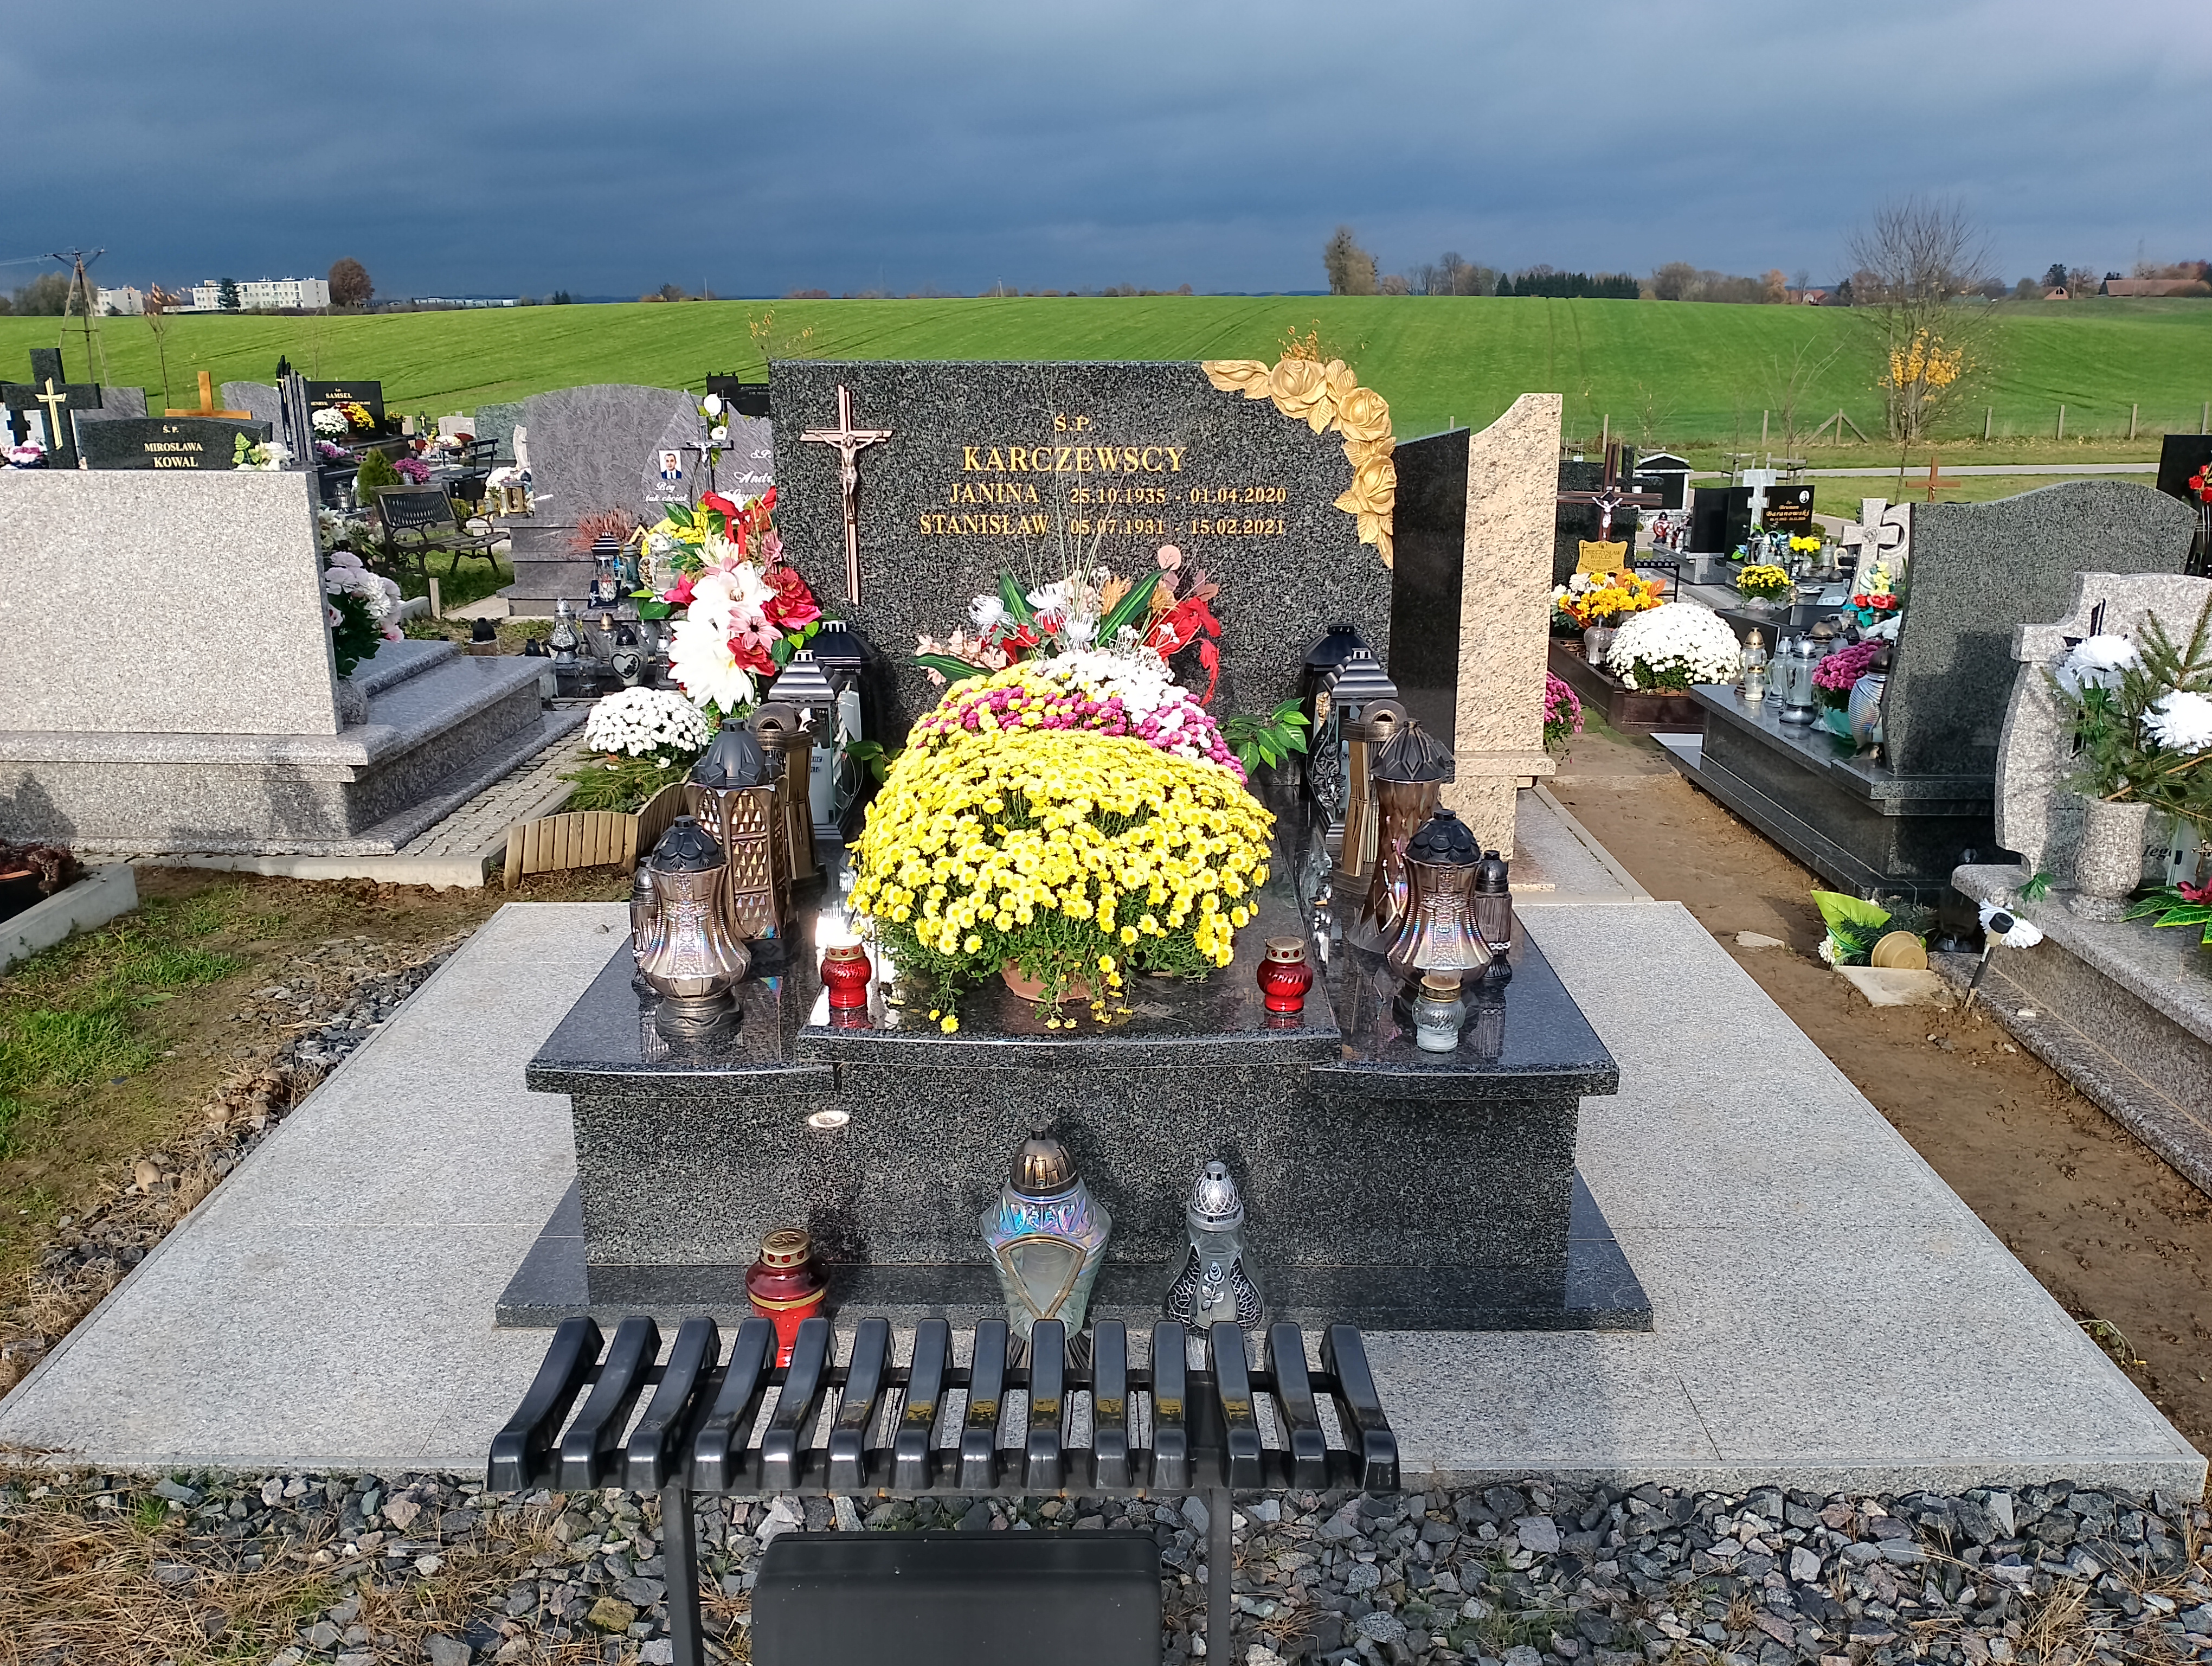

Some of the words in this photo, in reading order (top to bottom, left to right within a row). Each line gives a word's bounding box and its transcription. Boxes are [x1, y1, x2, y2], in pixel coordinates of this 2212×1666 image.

[153, 456, 199, 467] KOWAL
[962, 446, 1187, 472] KARCZEWSCY
[950, 483, 1039, 503] JANINA
[1070, 488, 1166, 503] 25.10.1935
[1190, 488, 1287, 503] 01.04.2020
[920, 515, 1050, 535] STANISŁAW
[1070, 519, 1165, 535] 05.07.1931
[1191, 519, 1284, 534] 15.02.2021
